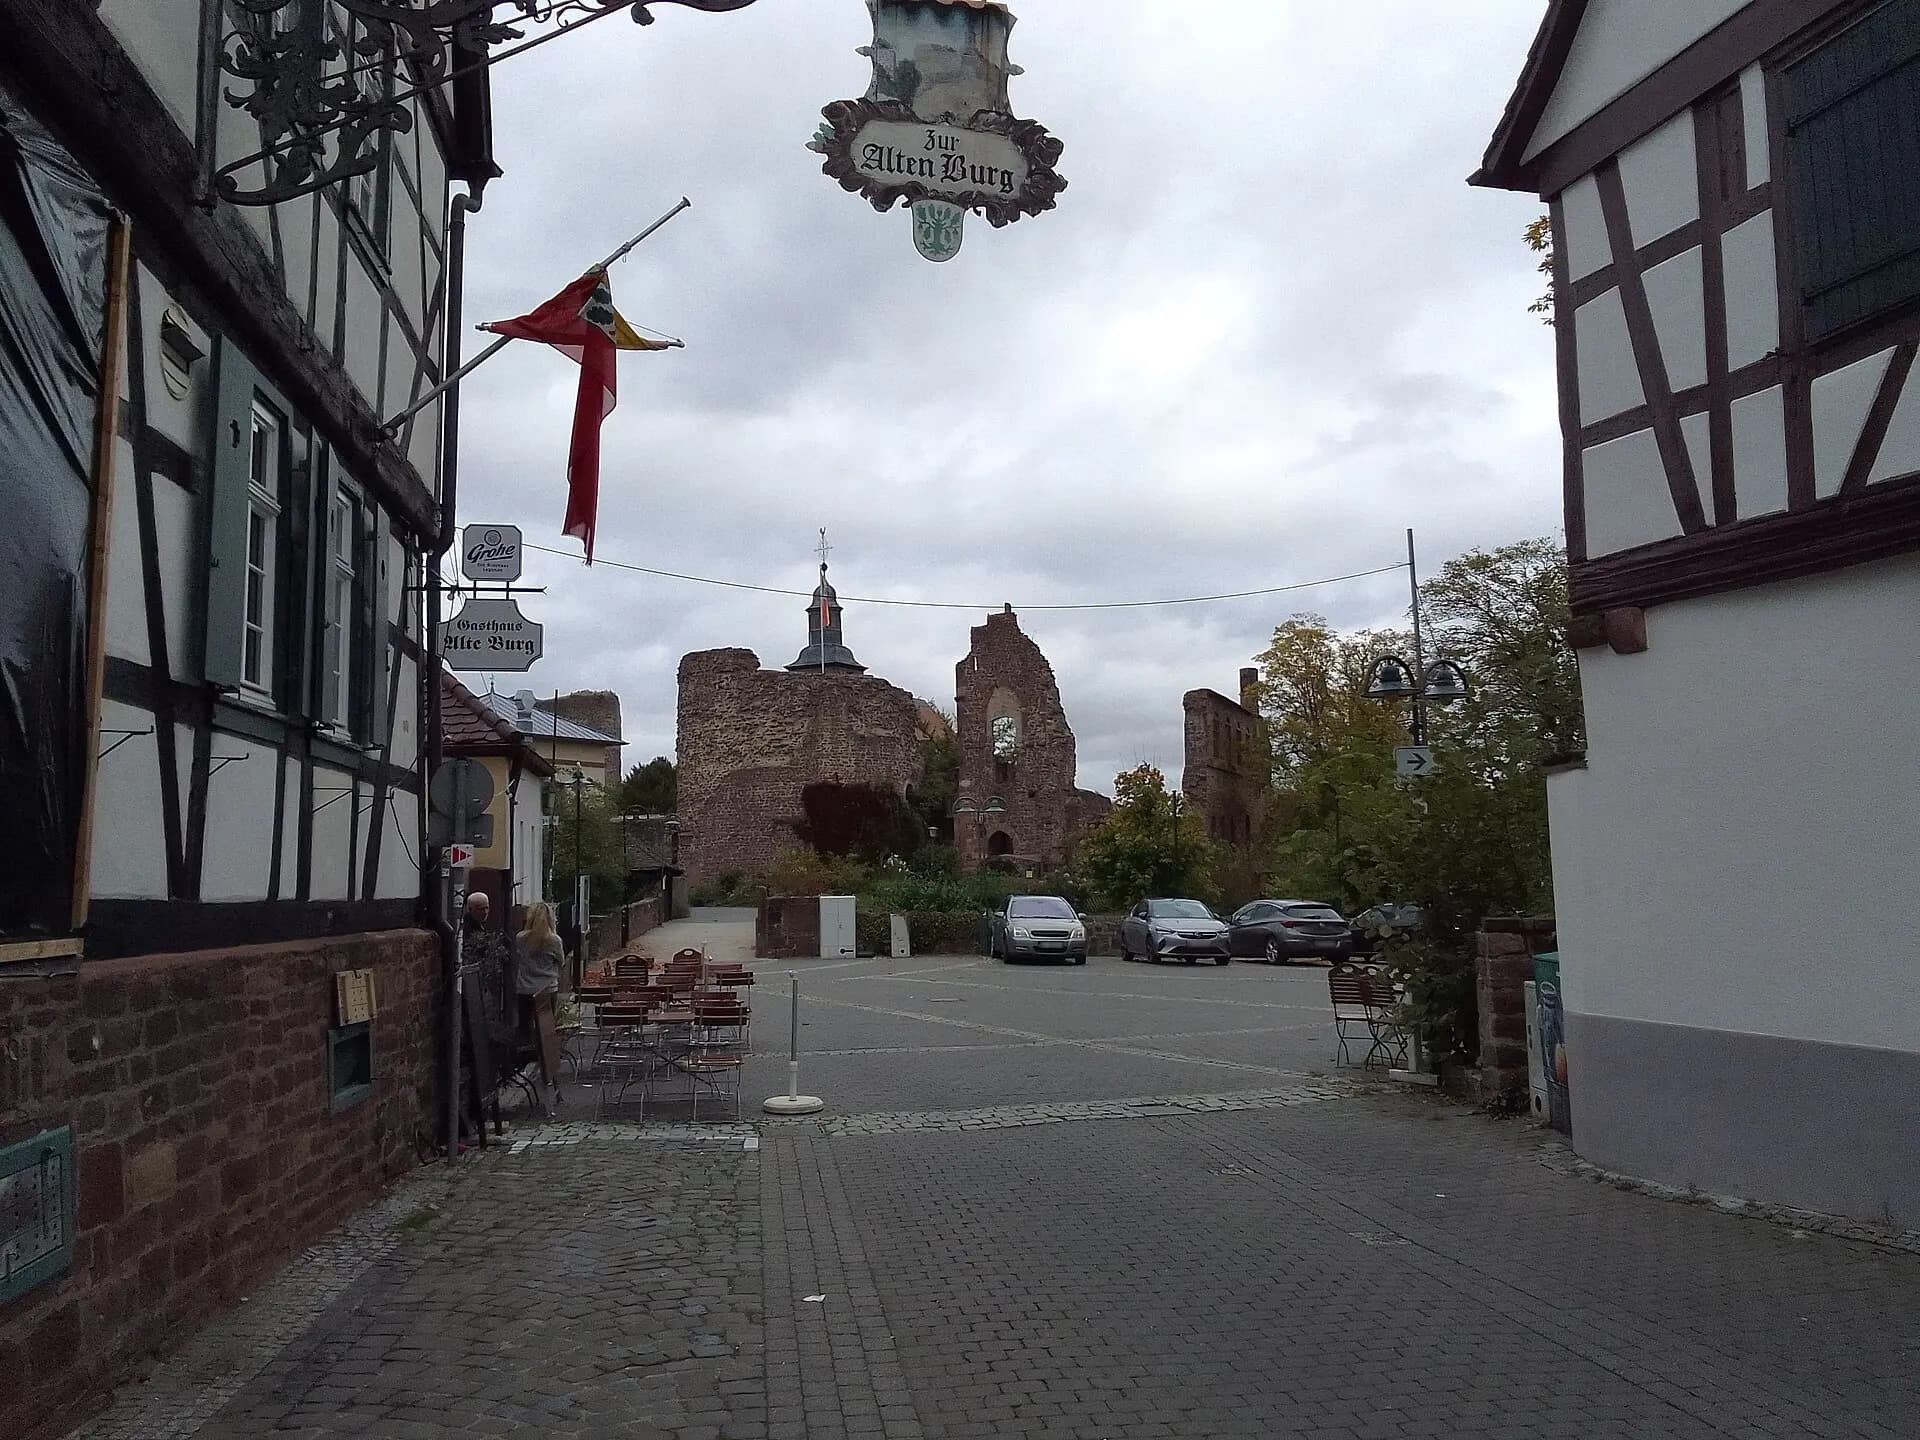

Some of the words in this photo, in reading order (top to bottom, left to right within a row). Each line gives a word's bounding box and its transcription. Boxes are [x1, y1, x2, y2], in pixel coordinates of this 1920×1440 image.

[861, 143, 936, 178] Alten
[940, 154, 1014, 193] Burg
[467, 543, 516, 563] Grohe
[456, 619, 523, 634] Gasthaus
[444, 635, 482, 650] Alte
[487, 635, 534, 655] Burg
